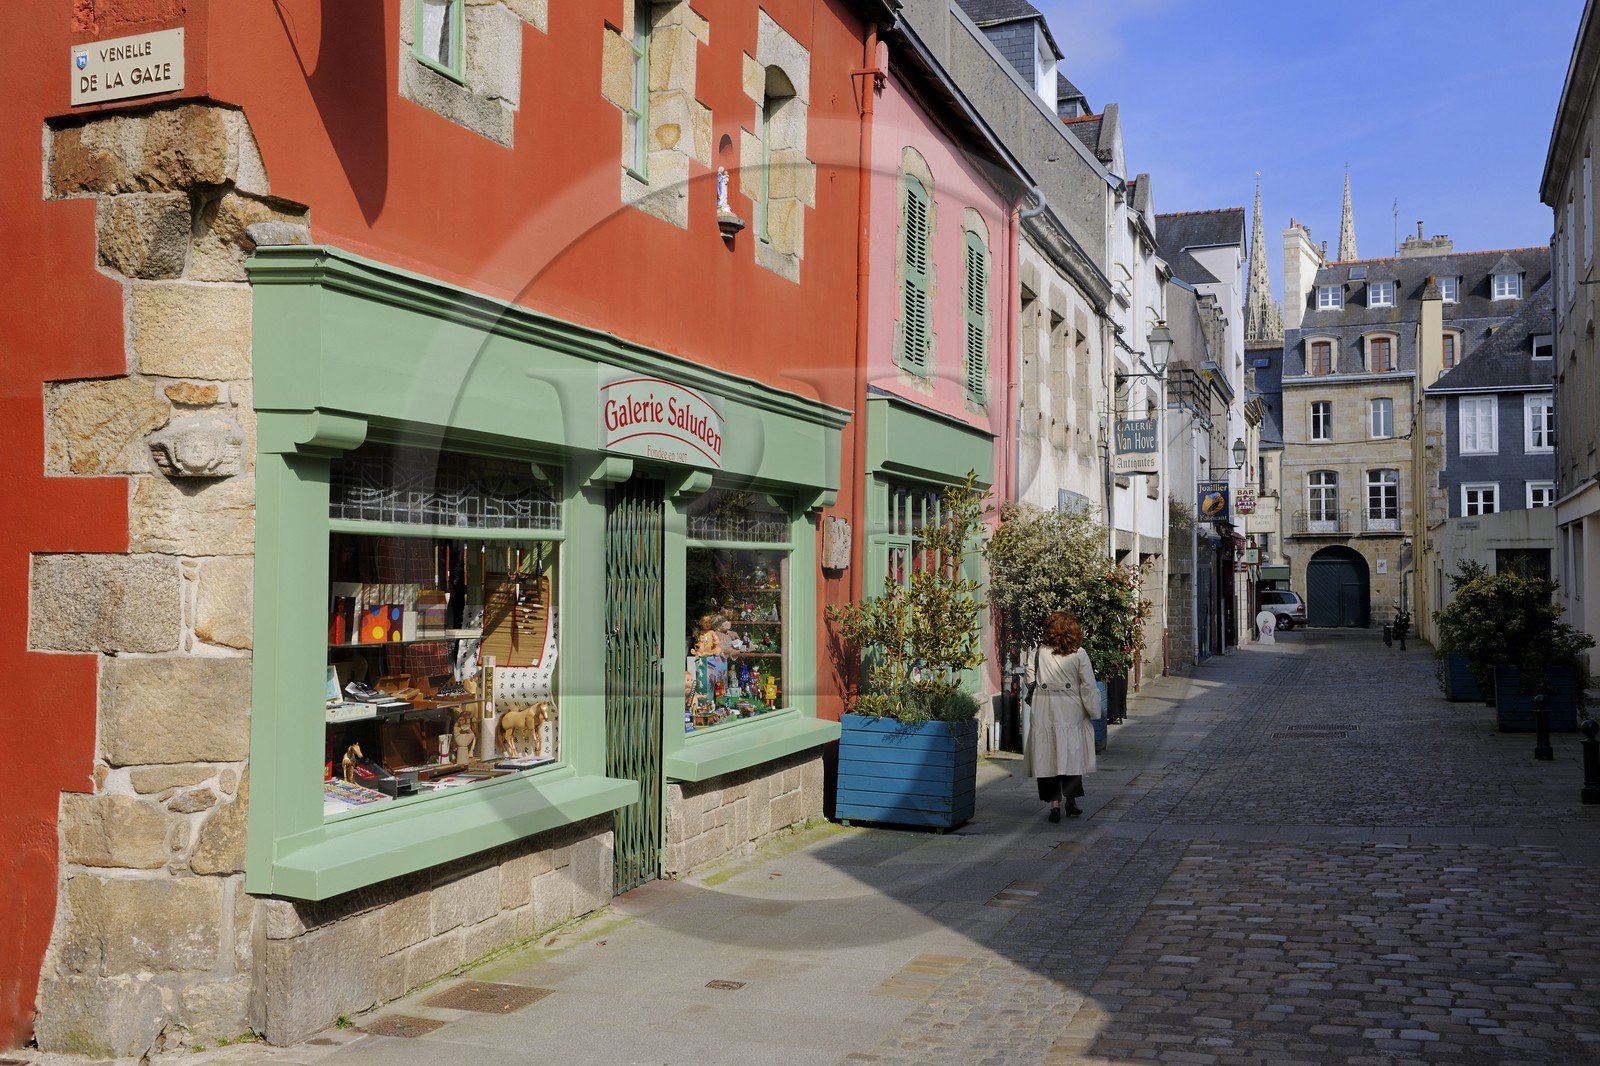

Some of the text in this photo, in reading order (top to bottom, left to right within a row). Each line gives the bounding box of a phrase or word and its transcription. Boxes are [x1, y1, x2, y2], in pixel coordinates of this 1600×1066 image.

[100, 42, 152, 62] VENELLE
[81, 63, 171, 93] DE LA GAZE
[604, 393, 722, 457] Galerie Saluden
[1117, 422, 1154, 431] GALERIE
[1117, 433, 1155, 450] Van Hove
[1117, 456, 1155, 469] Antiquités
[1199, 484, 1227, 493] Joaillier
